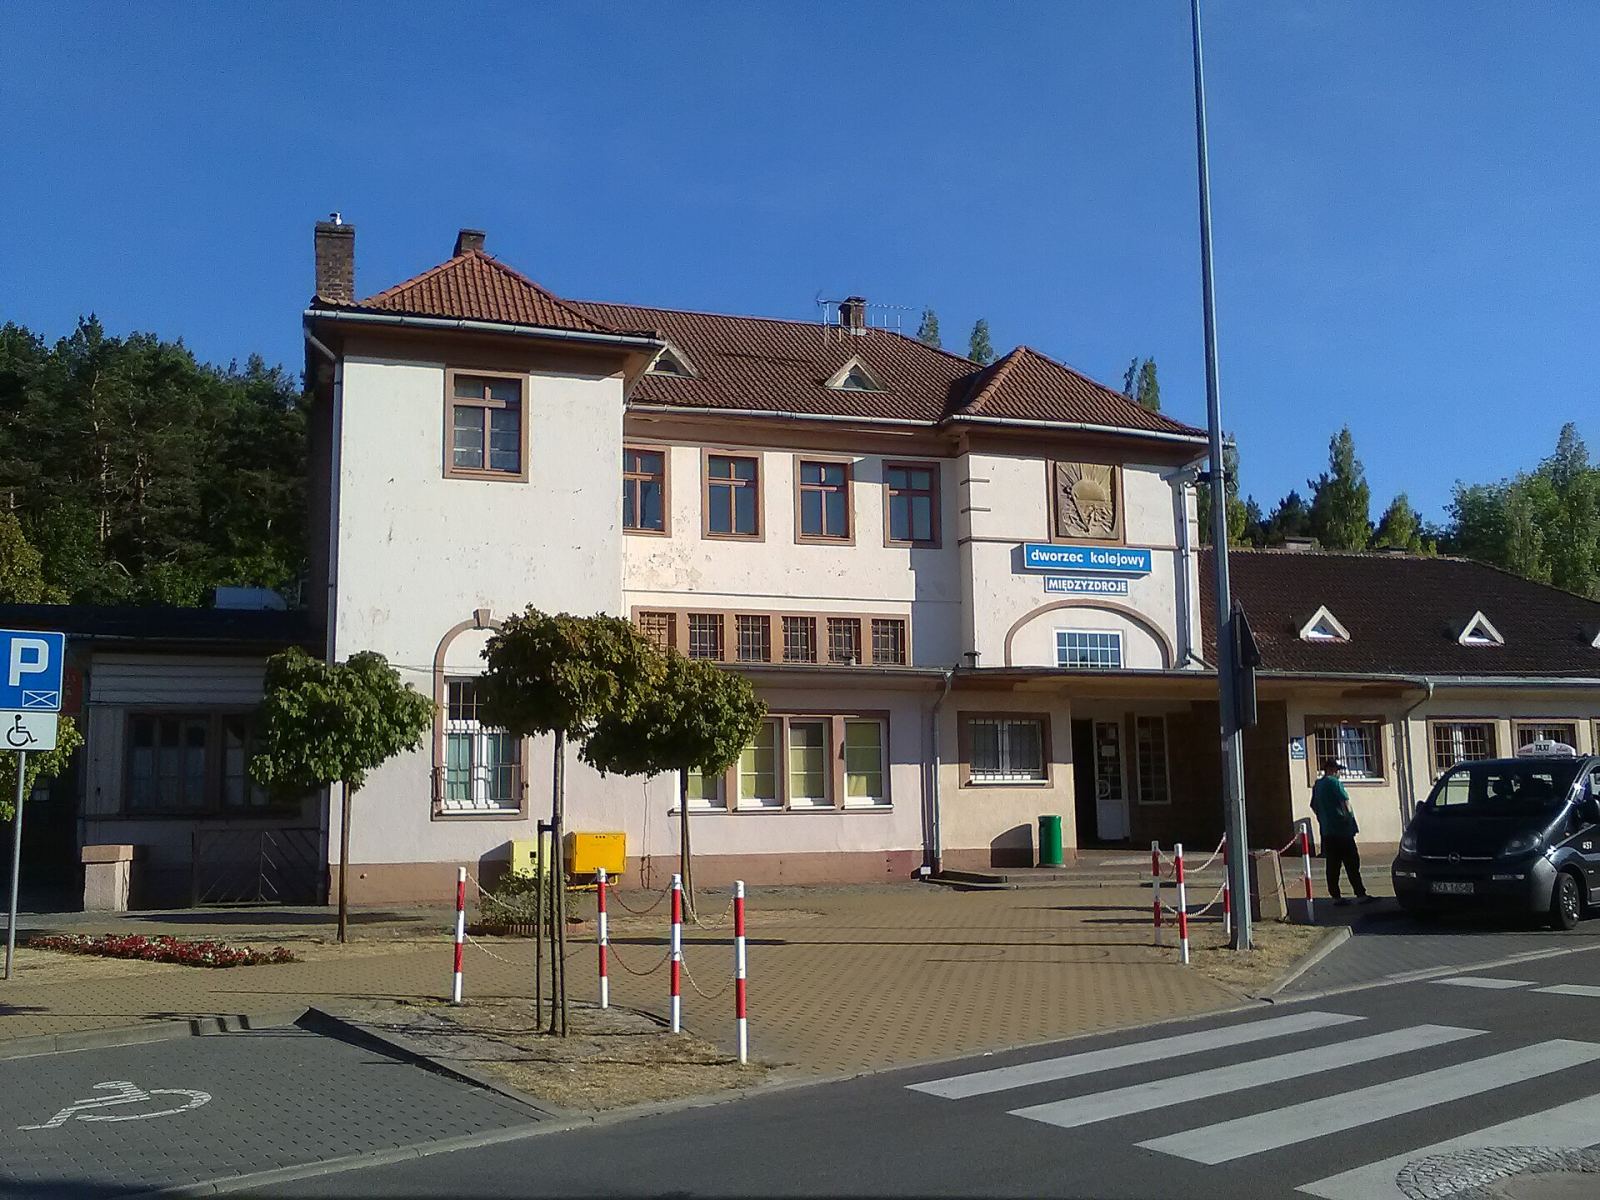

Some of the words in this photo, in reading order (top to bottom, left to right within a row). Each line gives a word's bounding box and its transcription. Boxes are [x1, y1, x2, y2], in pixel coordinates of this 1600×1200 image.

[1031, 549, 1083, 563] dworzec
[1090, 551, 1145, 567] kolejowy
[1049, 579, 1127, 592] MIĘDZYZDROJE
[9, 637, 49, 686] P
